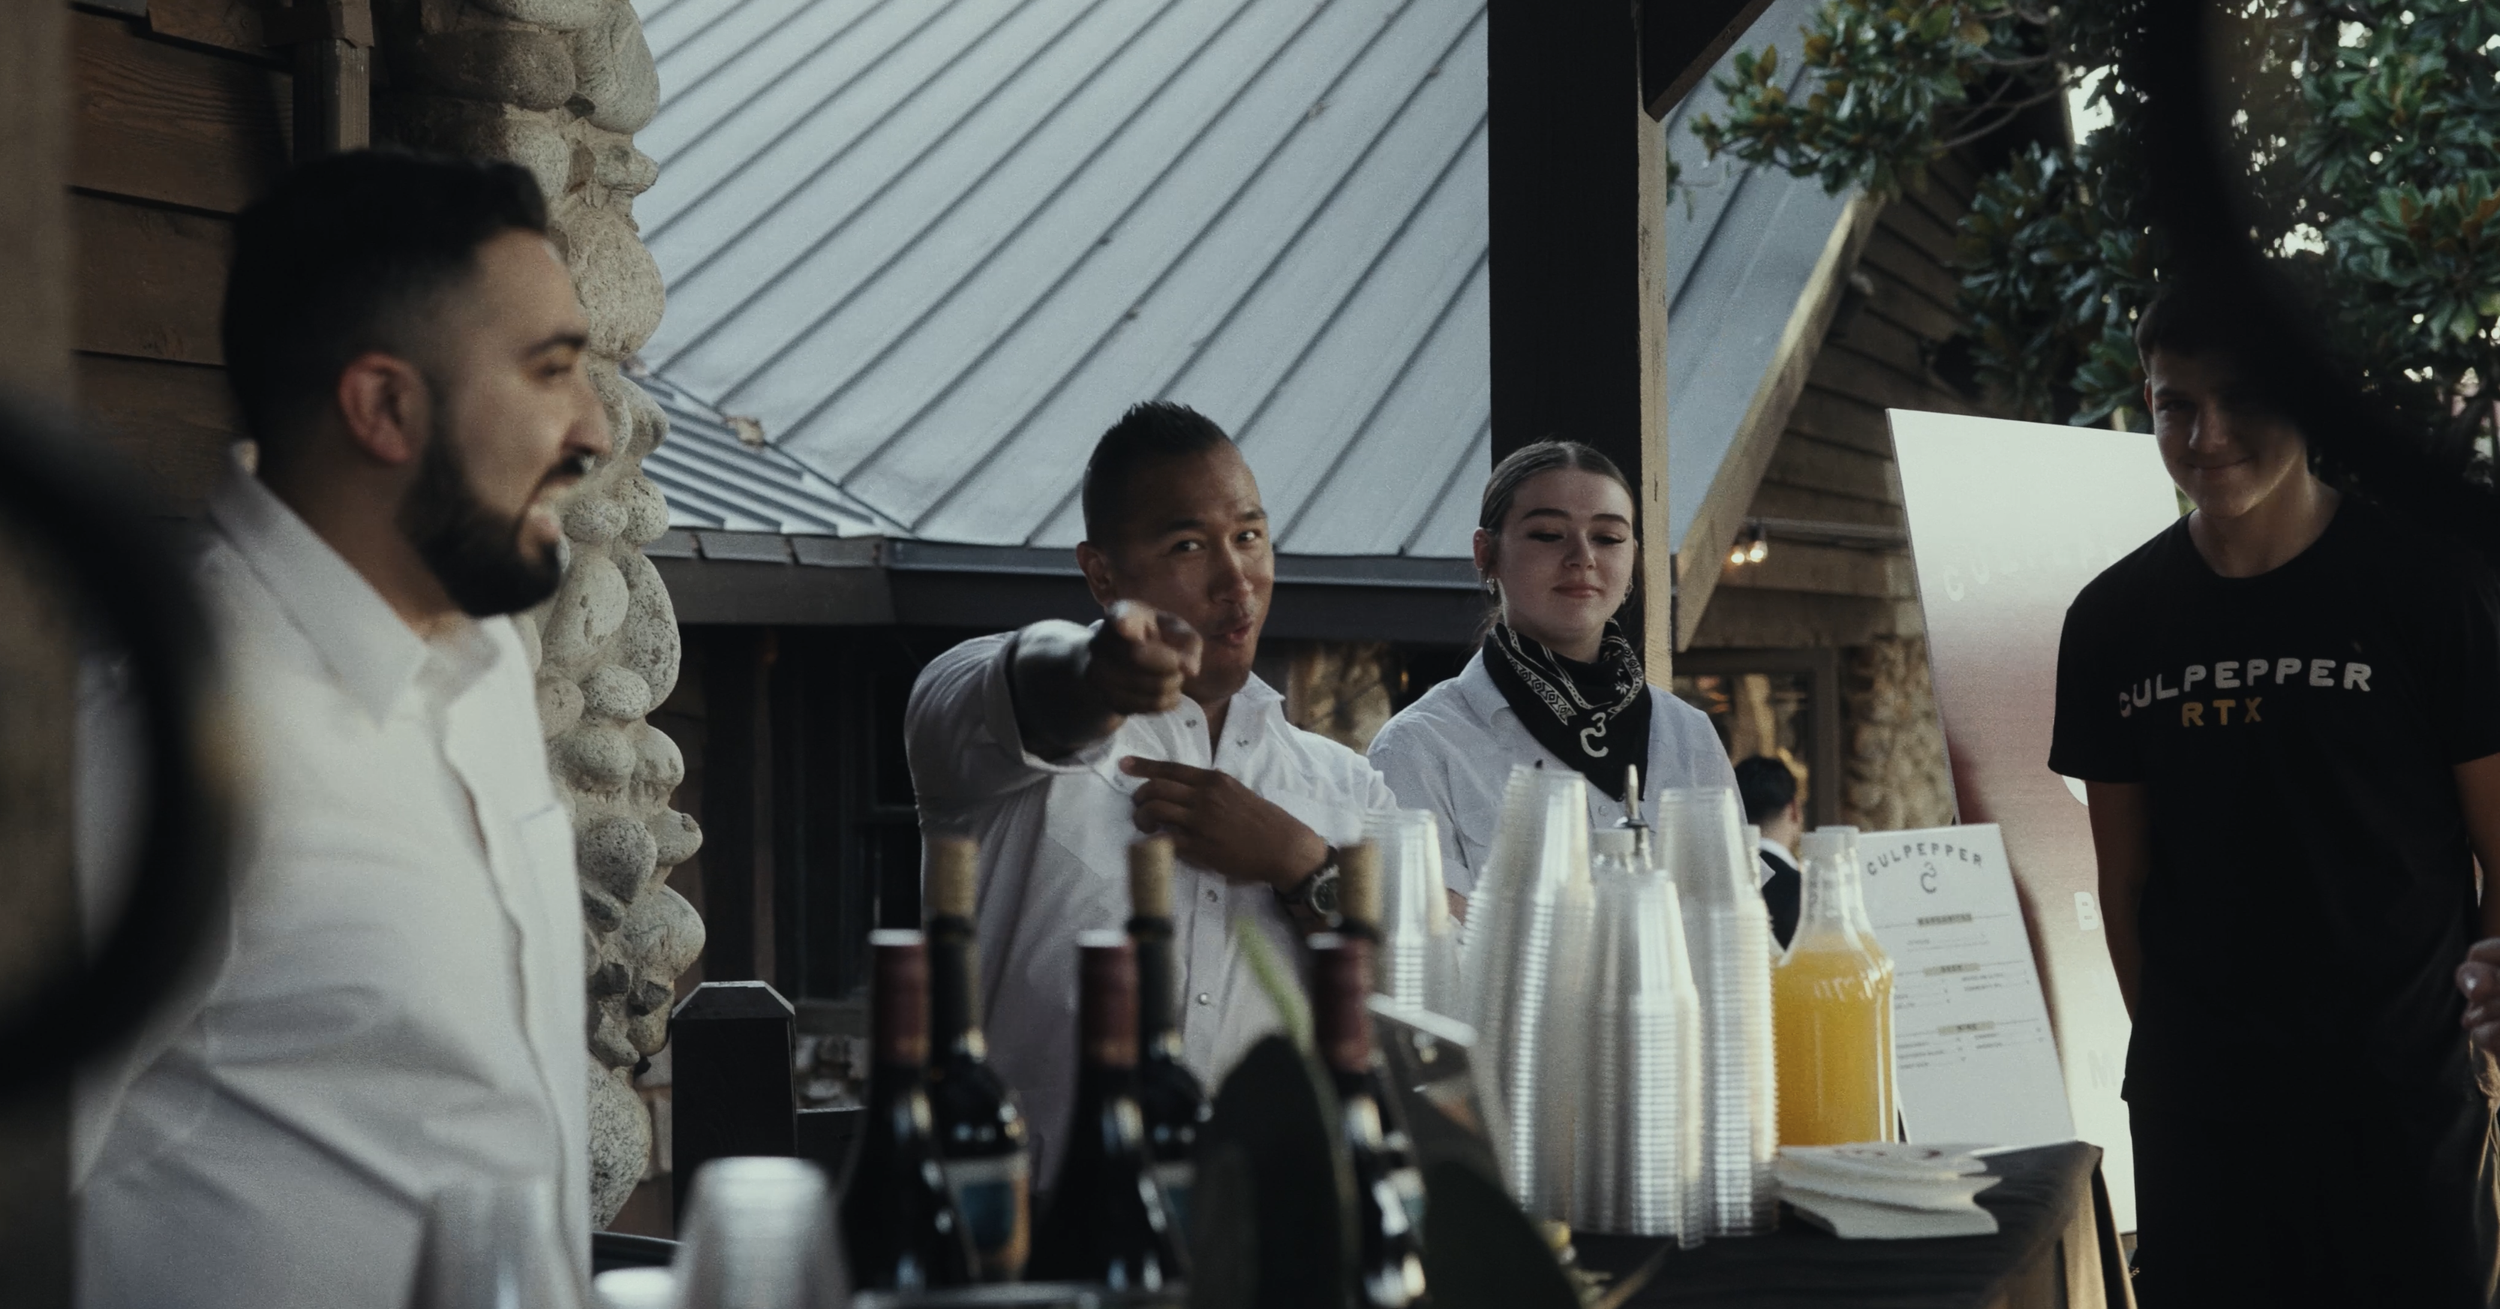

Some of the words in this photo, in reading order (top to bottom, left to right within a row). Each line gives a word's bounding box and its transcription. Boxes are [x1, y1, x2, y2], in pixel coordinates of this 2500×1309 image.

[2119, 657, 2372, 718] CULPEPPER
[2181, 697, 2263, 727] RTX
[1867, 842, 1982, 876] CULPEPPER
